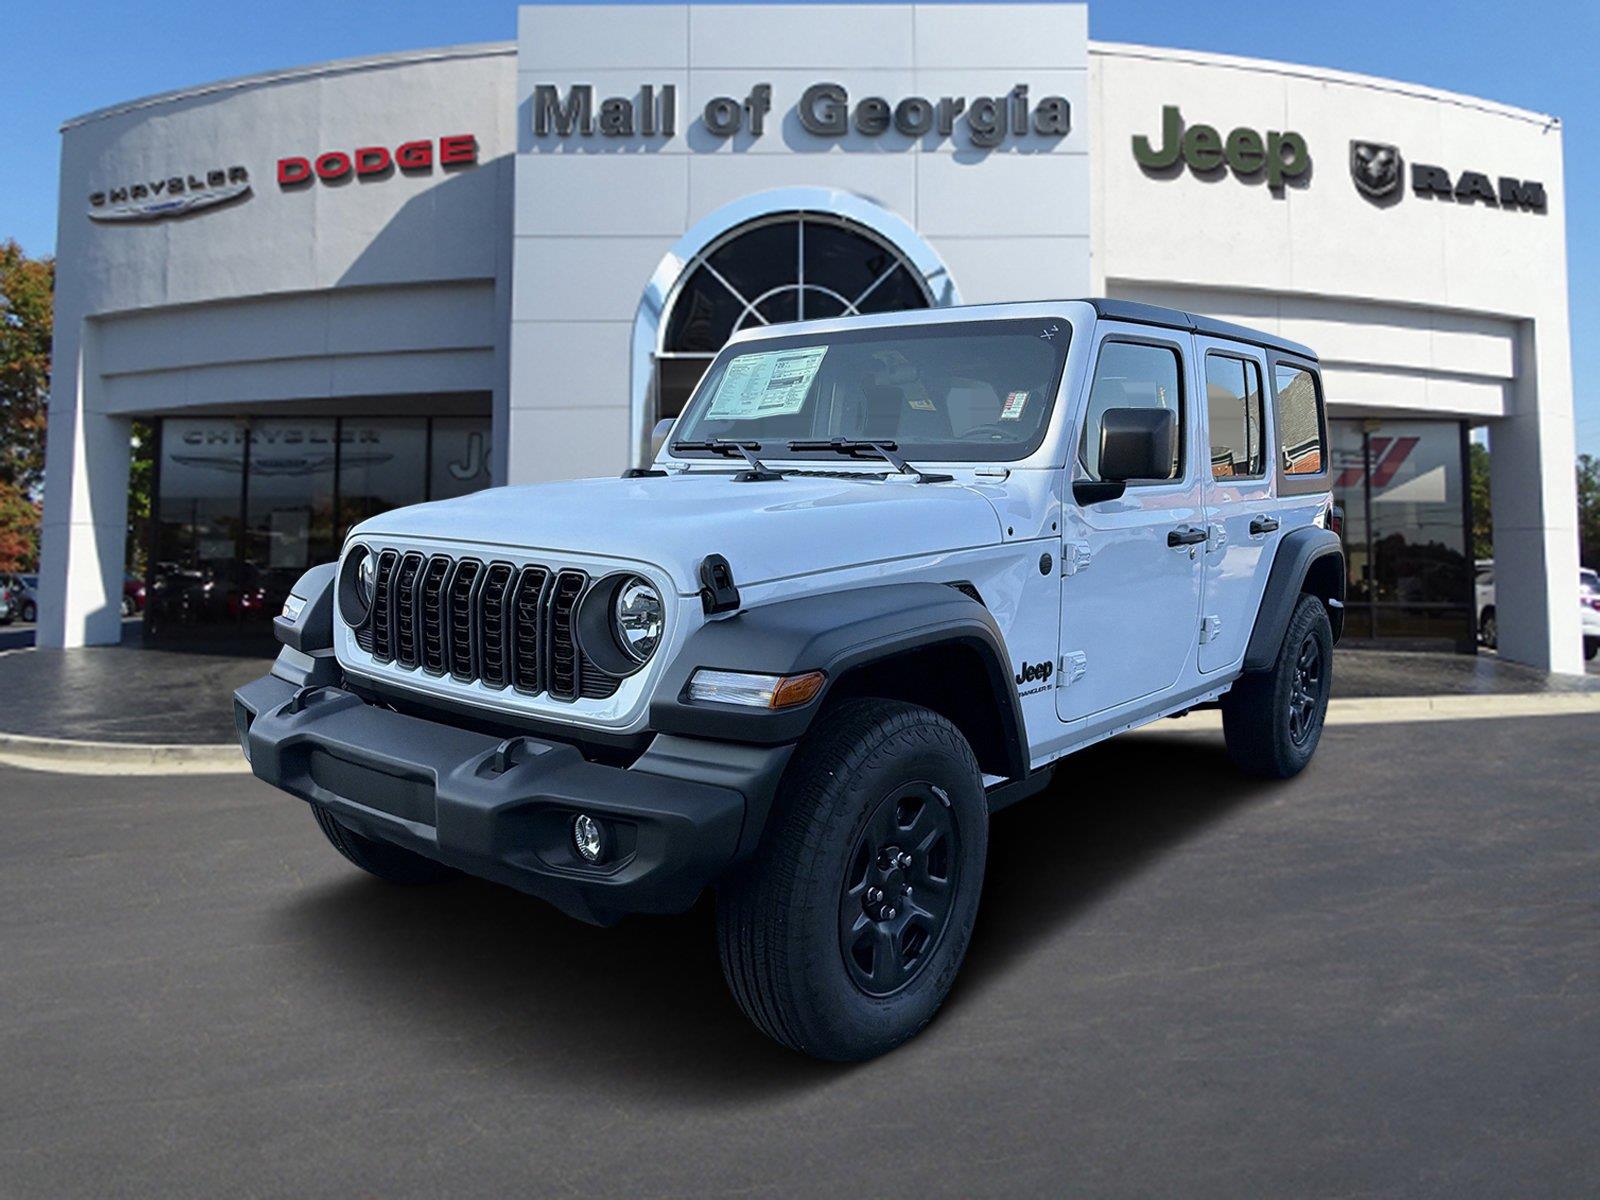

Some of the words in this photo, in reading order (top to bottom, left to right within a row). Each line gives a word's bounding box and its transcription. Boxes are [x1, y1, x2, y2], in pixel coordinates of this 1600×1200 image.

[532, 83, 677, 137] Mall
[703, 82, 772, 136] of
[800, 82, 1073, 149] Georgia
[277, 134, 478, 186] DODGE
[1131, 105, 1311, 192] Jeep
[89, 165, 249, 207] CHRYSLER
[1411, 162, 1547, 212] RAM
[1015, 660, 1053, 685] Jeep
